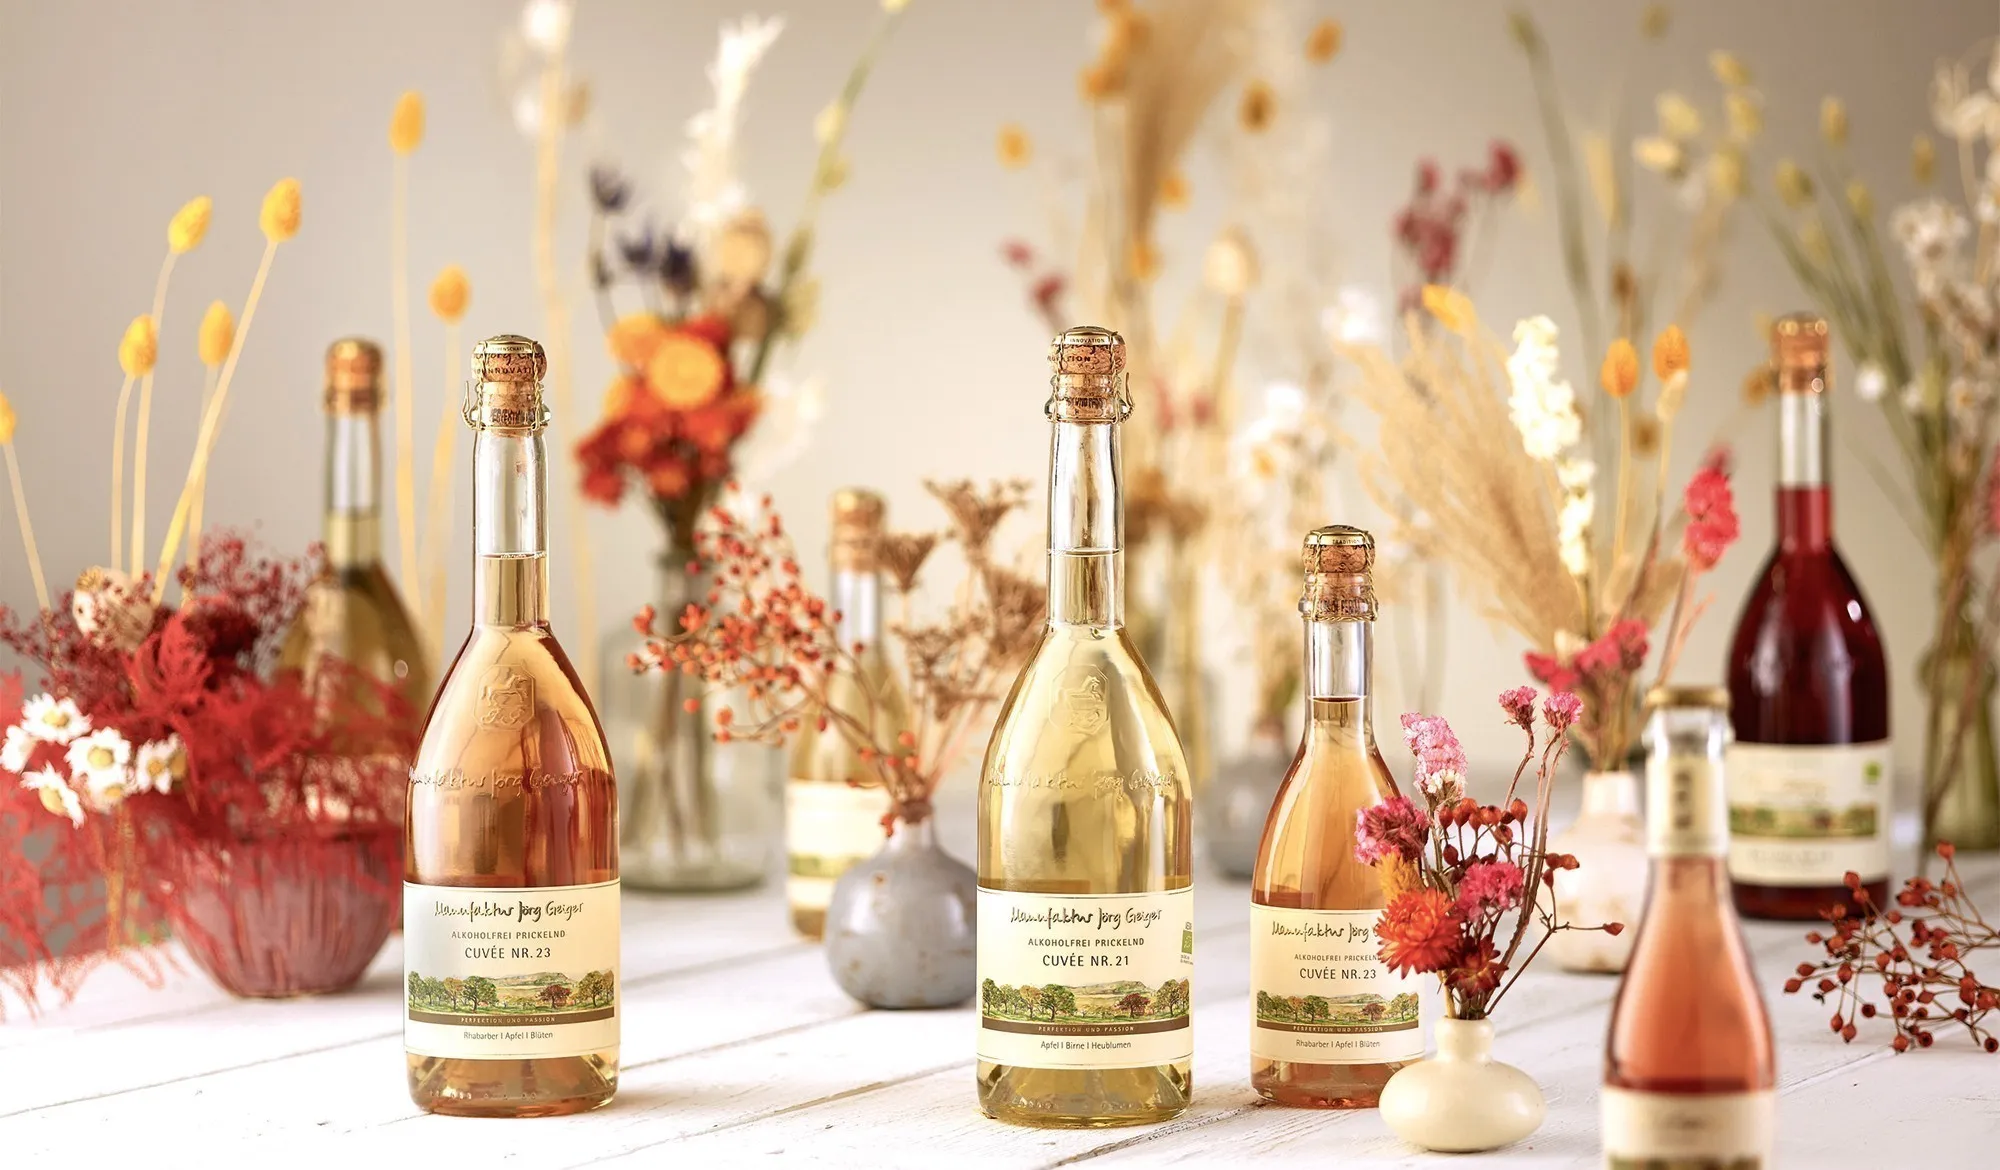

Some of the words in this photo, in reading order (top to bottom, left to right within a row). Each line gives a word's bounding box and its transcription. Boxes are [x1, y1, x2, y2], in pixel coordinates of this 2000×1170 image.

[434, 901, 515, 922] Manufaktur
[517, 901, 542, 923] Jörg
[545, 900, 584, 921] Geiger
[1011, 907, 1094, 929] Manufaktur
[1097, 907, 1122, 930] Jörg
[1125, 907, 1162, 928] Geiger
[451, 930, 512, 940] ALKOHOLFREI
[516, 929, 566, 939] PRICKELND
[1271, 920, 1345, 943] Manufaktur
[1348, 922, 1370, 943] Jörg
[1027, 938, 1091, 948] ALKOHOLFREI
[1095, 937, 1145, 947] PRICKELND
[465, 945, 505, 959] CUVÉE
[1294, 953, 1341, 962] ALKOHOLFREI
[1042, 952, 1085, 967] CUVÉE
[1299, 966, 1337, 980] CUVÉE
[1038, 1025, 1083, 1033] PERFEKTION
[463, 1030, 499, 1041] Rhabarber
[505, 1030, 524, 1042] Apfel
[530, 1030, 554, 1040] Blüten
[1040, 1040, 1060, 1051] Apfel
[1065, 1040, 1085, 1050] Birne
[1091, 1040, 1132, 1050] Heublumen
[1295, 1038, 1330, 1049] Rhabarber
[1335, 1040, 1354, 1050] Apfel
[1359, 1039, 1381, 1048] Blüten
